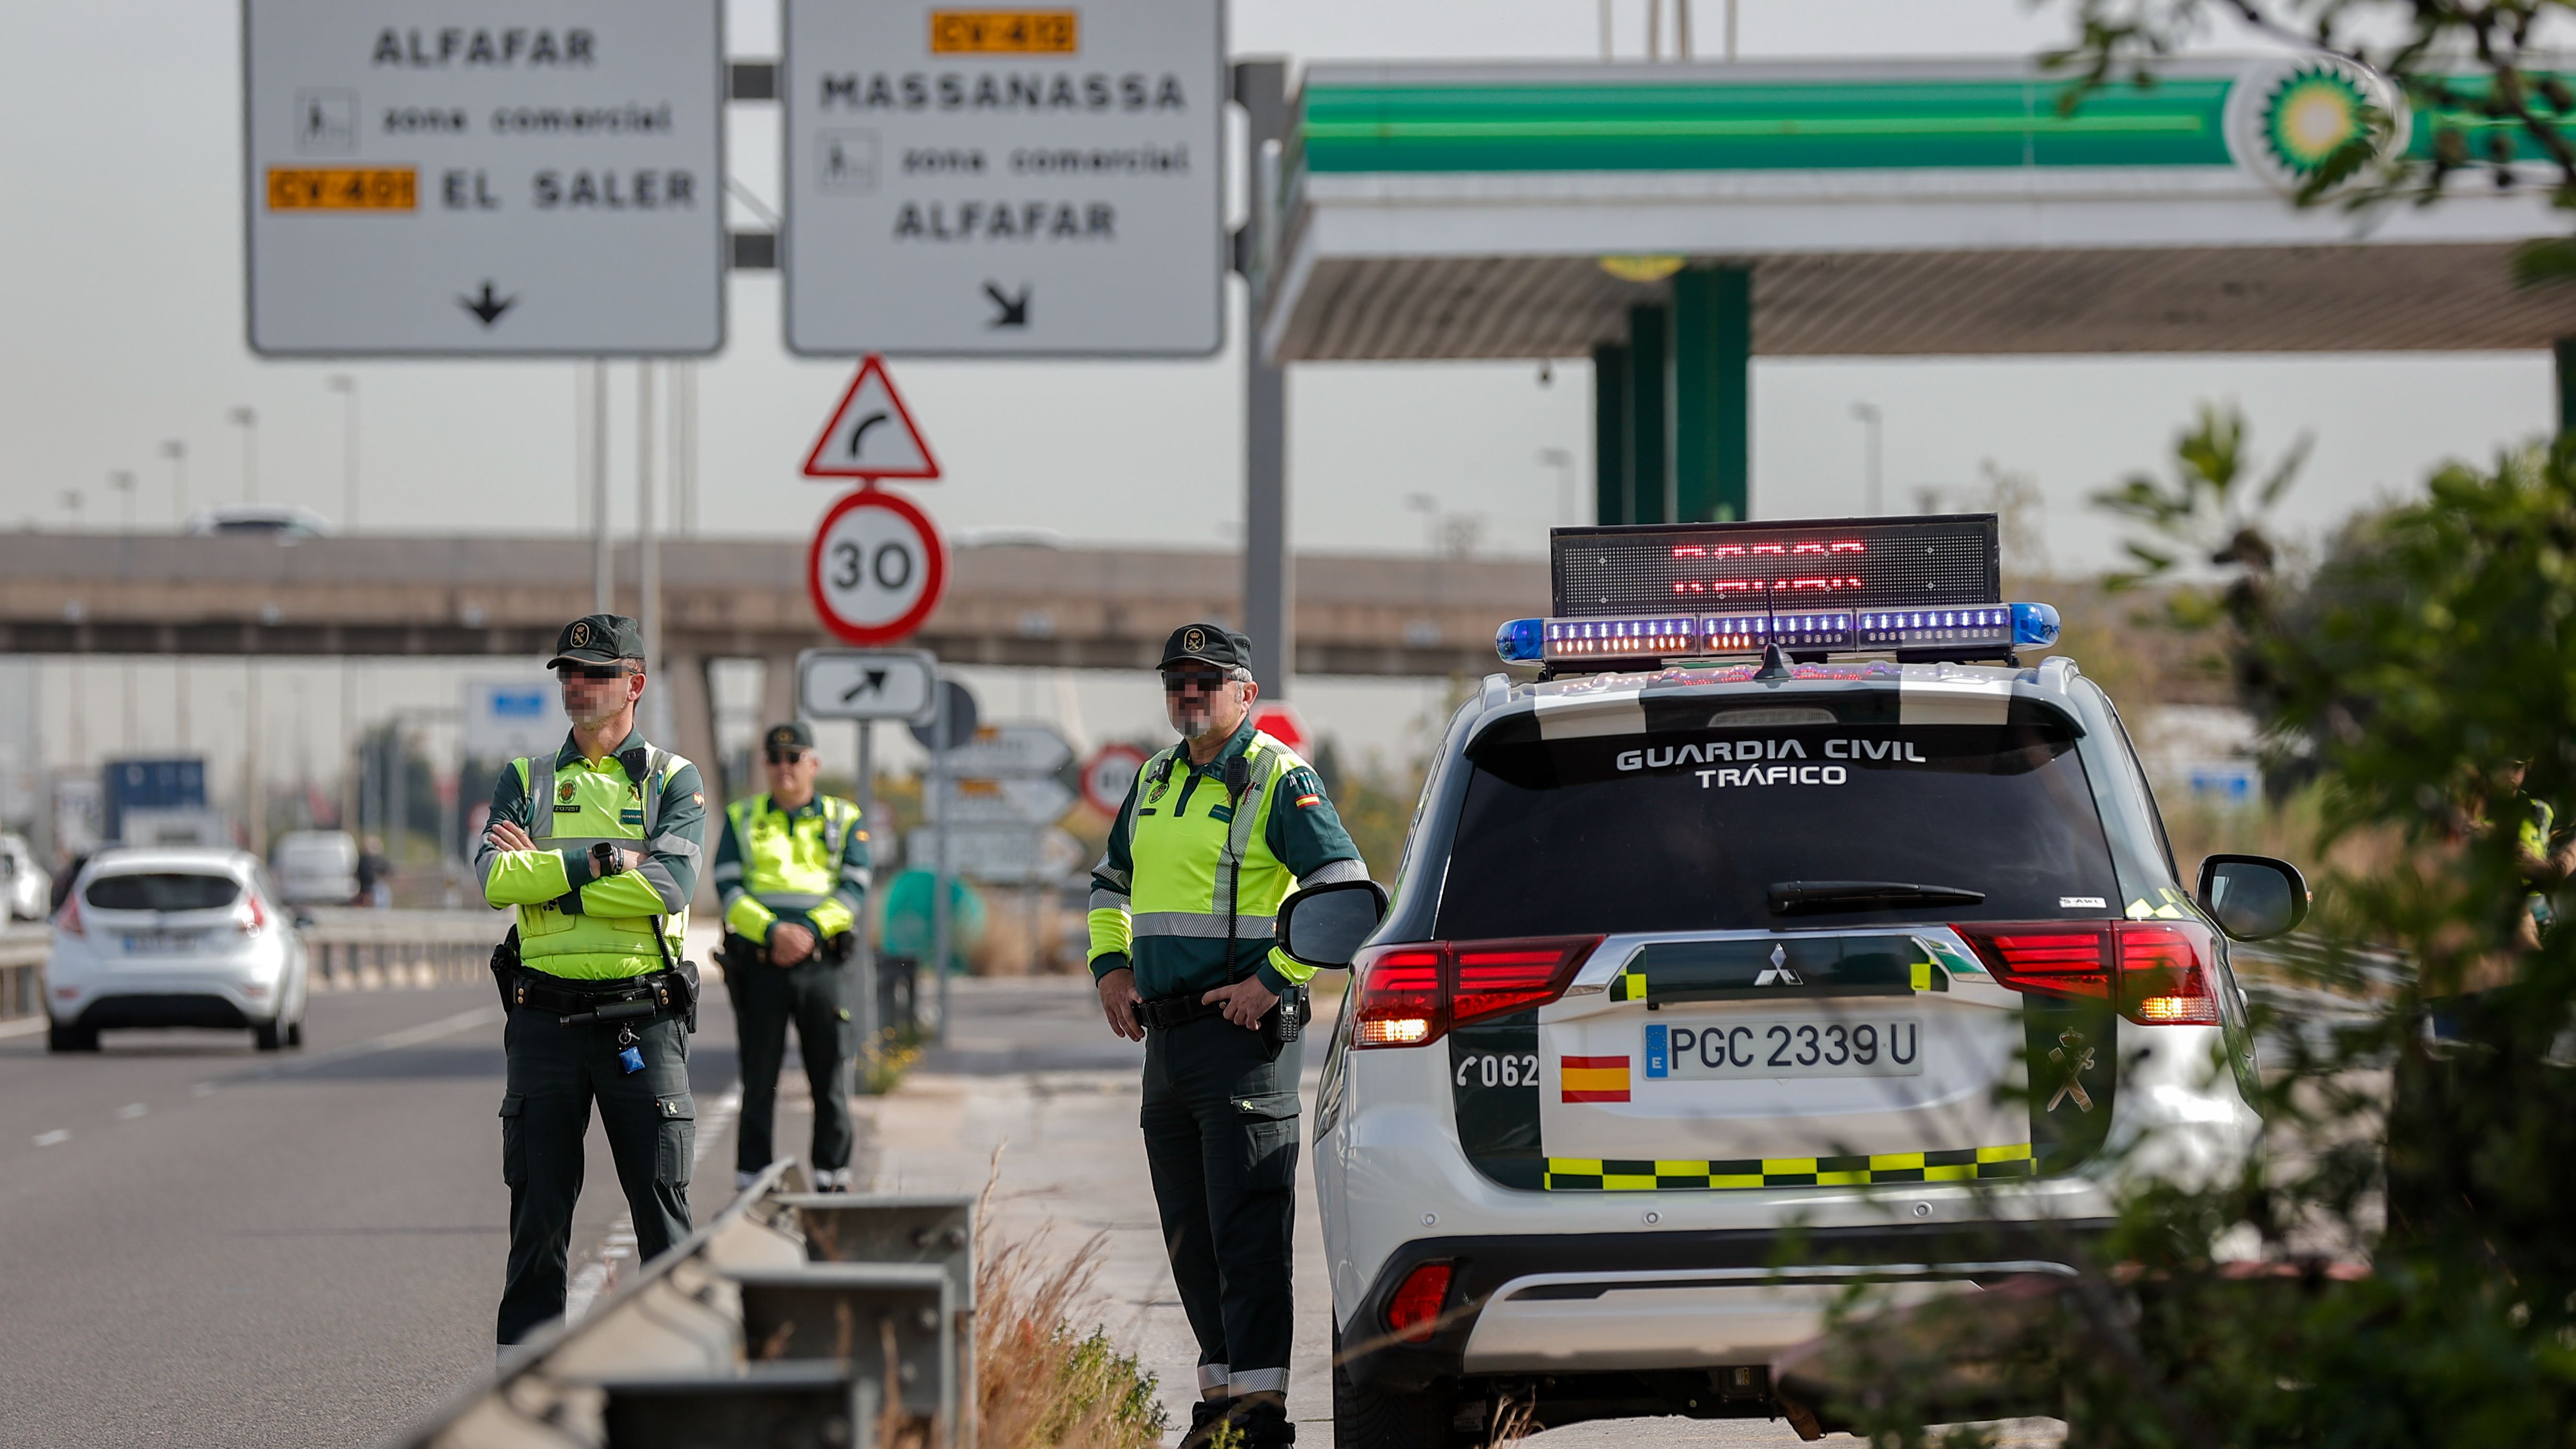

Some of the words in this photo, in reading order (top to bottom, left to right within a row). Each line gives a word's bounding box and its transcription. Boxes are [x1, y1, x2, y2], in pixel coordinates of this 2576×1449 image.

[372, 28, 597, 67] ALFAFAR
[820, 74, 1186, 110] MASSANASSA
[383, 108, 469, 135] zona
[490, 103, 673, 135] comercial
[901, 148, 986, 174] zona
[1011, 143, 1190, 174] comercial
[442, 171, 499, 208] EL
[535, 171, 697, 208] SALER
[895, 203, 1117, 240] ALFAFAR
[831, 540, 912, 590] 30
[1617, 739, 1807, 770] GUARDIA
[1824, 739, 1926, 763] CIVIL
[1695, 763, 1847, 788] TRÁFICO
[1651, 1057, 1662, 1069] E
[1671, 1026, 1755, 1070] PGC
[1767, 1024, 1878, 1067] 2339
[1891, 1023, 1916, 1065] U
[1481, 1054, 1539, 1088] 062
